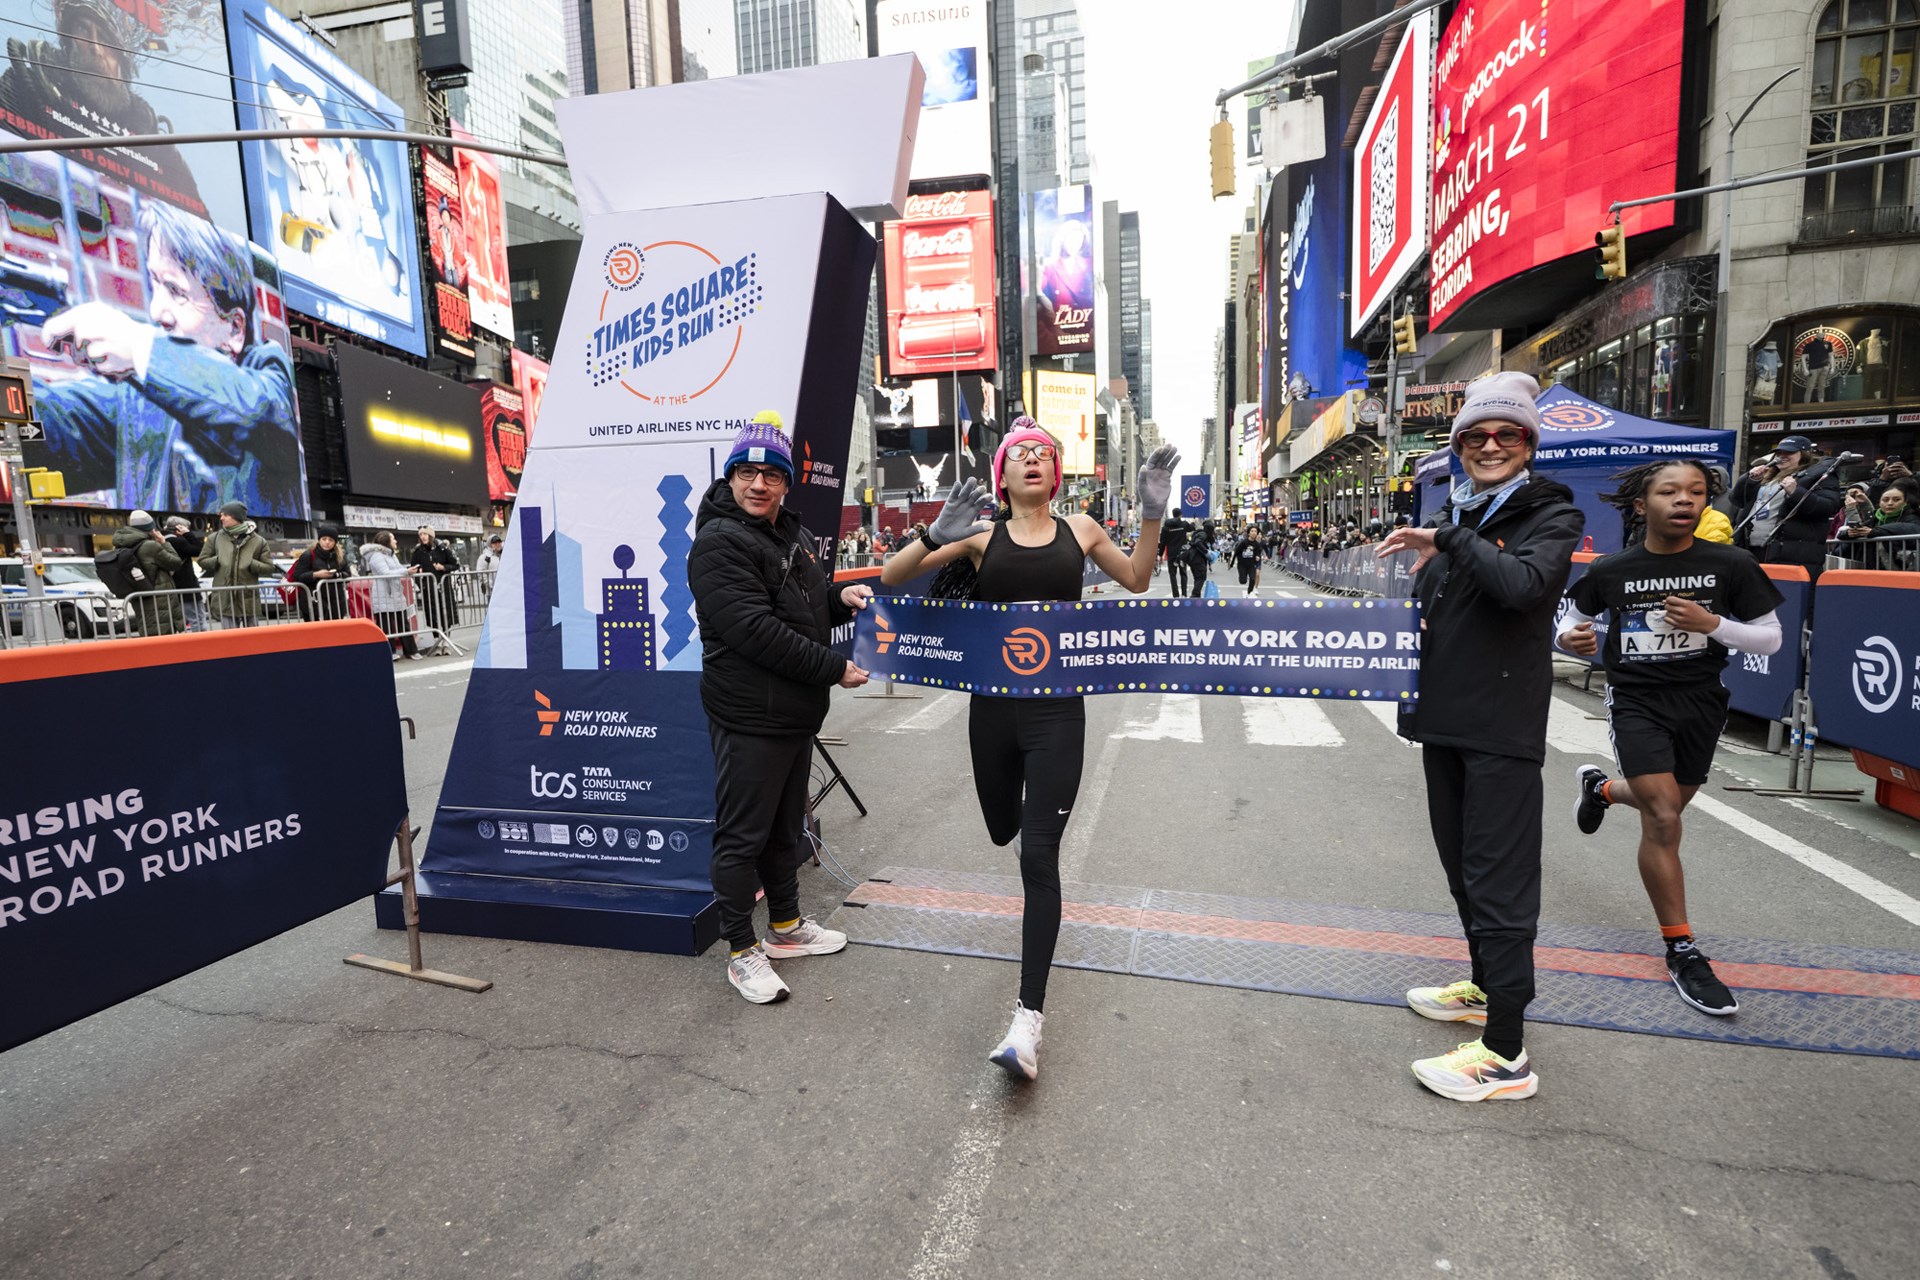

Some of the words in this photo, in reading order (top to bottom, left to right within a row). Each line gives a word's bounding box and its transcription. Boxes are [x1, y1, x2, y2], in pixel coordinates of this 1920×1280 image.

[892, 6, 970, 27] SAMSUNG
[1437, 40, 1459, 91] TUNE
[1460, 8, 1475, 52] IN:
[1461, 20, 1536, 133] peacock
[1433, 124, 1494, 234] MARCH
[1505, 87, 1550, 161] 21
[97, 156, 130, 178] ONLY
[134, 172, 148, 187] IN
[1431, 188, 1510, 287] SEBRING,
[634, 246, 646, 263] YORK
[604, 275, 618, 290] ROAD
[619, 272, 645, 292] RUNNERS
[1431, 256, 1473, 318] FLORIDA
[593, 302, 655, 358] TIMES
[661, 256, 748, 325] SQUARE
[1054, 309, 1092, 325] LADY
[633, 334, 673, 369] KIDS
[678, 308, 714, 348] RUN
[1042, 384, 1073, 394] come
[1075, 384, 1086, 394] in
[1411, 384, 1441, 394] COOLEST
[653, 396, 666, 406] AT
[668, 395, 688, 406] THE
[589, 424, 633, 436] UNITED
[637, 421, 692, 434] AIRLINES
[696, 419, 721, 431] NYC
[1757, 422, 1779, 430] GIFTS
[1536, 450, 1567, 460] NEW
[1571, 447, 1606, 457] YORK
[1610, 445, 1649, 455] ROAD
[1653, 443, 1719, 453] RUNNERS
[812, 461, 823, 472] NEW
[823, 463, 834, 475] YORK
[810, 474, 823, 485] ROAD
[822, 476, 840, 489] RUNNERS
[1624, 574, 1717, 594] RUNNING
[1632, 602, 1653, 610] Pretty
[899, 633, 920, 645] NEW
[920, 635, 944, 648] YORK
[1059, 628, 1146, 650] RISING
[1154, 628, 1216, 647] NEW
[1222, 629, 1298, 648] YORK
[1305, 631, 1387, 650] ROAD
[1625, 637, 1639, 653] A
[1654, 632, 1690, 651] 712
[898, 645, 923, 657] ROAD
[923, 648, 963, 663] RUNNERS
[1060, 654, 1104, 669] TIMES
[1106, 652, 1167, 667] SQUARE
[1170, 652, 1206, 666] KIDS
[1208, 654, 1240, 667] RUN
[1243, 655, 1265, 667] AT
[1267, 655, 1300, 668] THE
[1303, 656, 1365, 669] UNITED
[564, 710, 593, 723] NEW
[595, 711, 629, 723] YORK
[564, 724, 598, 736] ROAD
[600, 726, 657, 738] RUNNERS
[582, 767, 612, 777] TATA
[531, 764, 577, 799] tcs
[582, 779, 652, 791] CONSULTANCY
[582, 791, 627, 802] SERVICES
[0, 788, 144, 846] RISING
[0, 835, 97, 884] NEW
[113, 803, 220, 851] YORK
[647, 833, 661, 845] MTA
[559, 851, 568, 859] City
[0, 867, 125, 928] ROAD
[141, 813, 301, 883] RUNNERS
